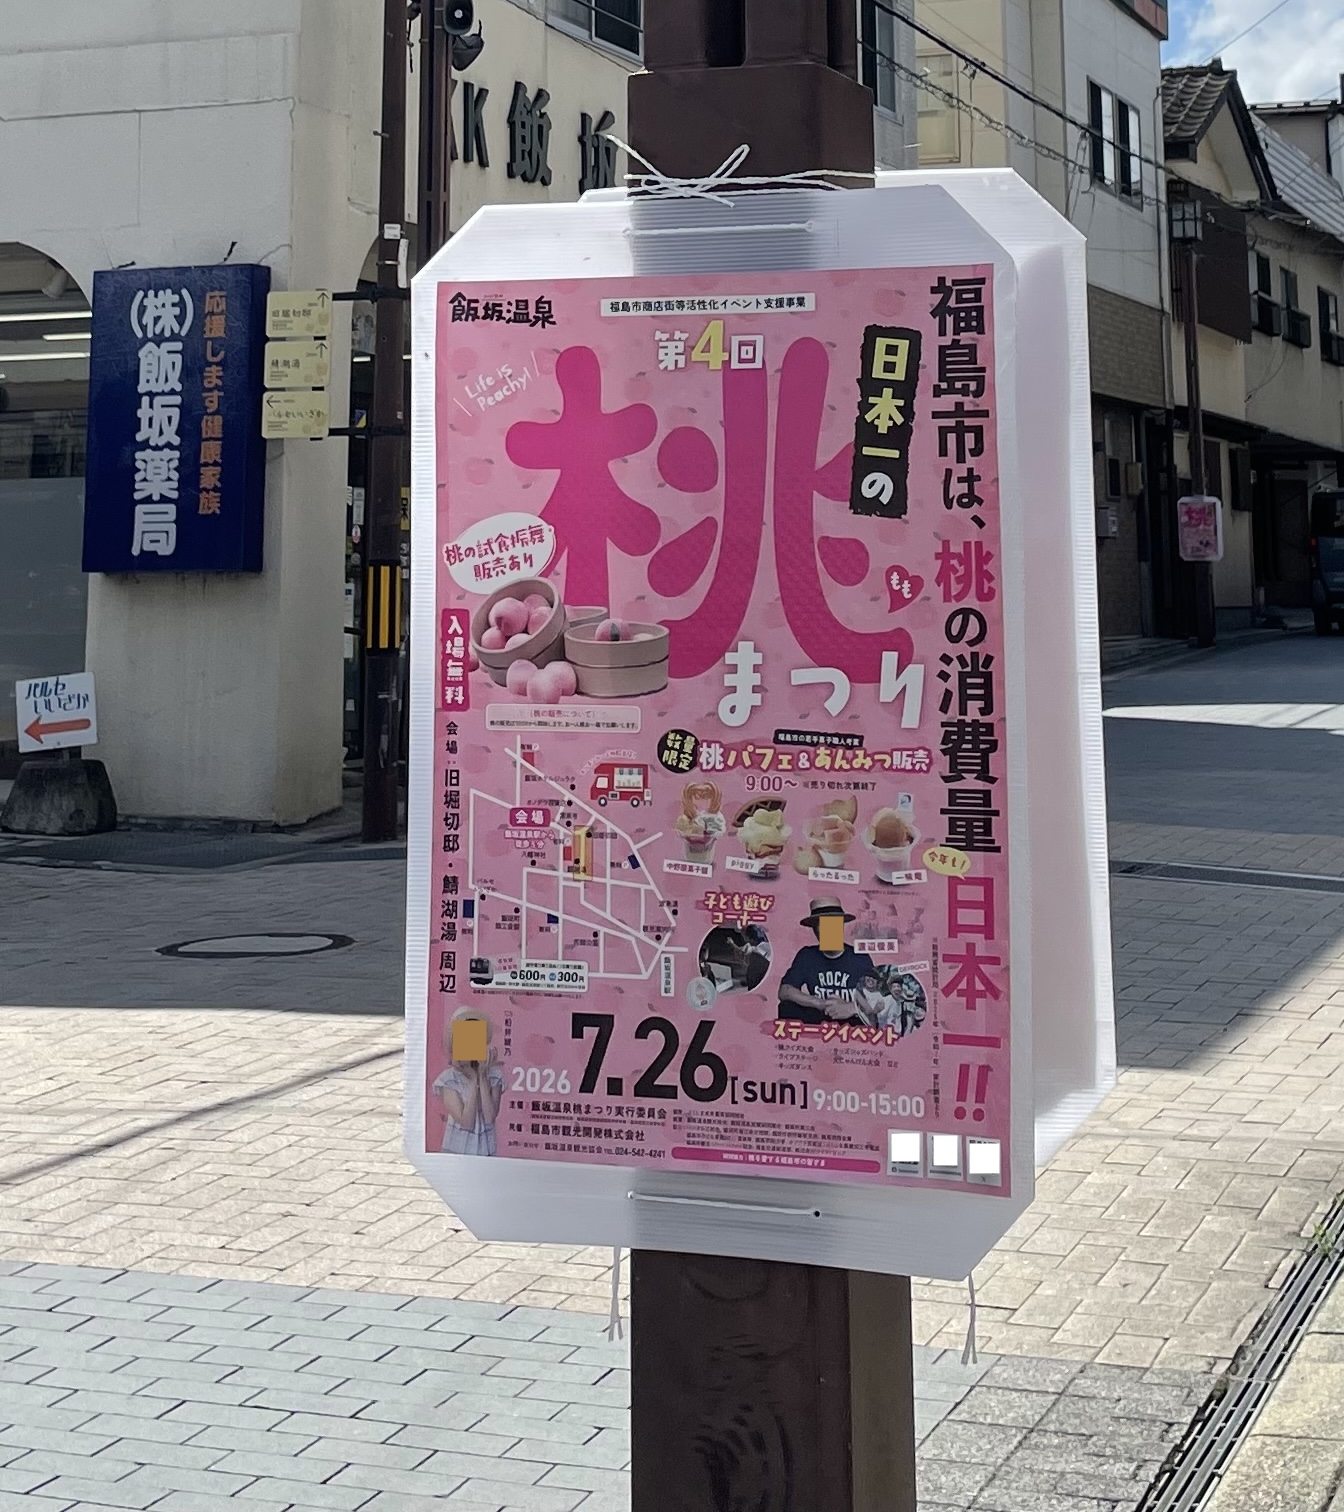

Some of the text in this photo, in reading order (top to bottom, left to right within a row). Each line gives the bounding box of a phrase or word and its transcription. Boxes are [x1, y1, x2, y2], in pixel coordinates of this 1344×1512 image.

[449, 292, 557, 329] 飯坂温泉
[609, 296, 807, 313] 福島市商店街等活性化イベント支援事業
[654, 319, 764, 370] 第4回
[464, 363, 513, 399] Life is
[197, 290, 227, 515] 応援します健康家族
[130, 287, 194, 557] (株)飯坂薬局
[859, 336, 909, 506] 日本一の
[505, 336, 914, 684] 桃
[445, 524, 545, 566] 桃の試食振舞
[473, 553, 534, 581] 販売あり
[890, 571, 913, 600] もも
[445, 616, 465, 705] 入場無料
[25, 675, 67, 700] パルセ
[718, 642, 925, 729] まつり
[666, 731, 696, 755] 数量
[699, 743, 931, 772] 桃パフェ&あんみつ販売
[661, 749, 694, 771] 限定
[515, 809, 544, 825] 会場
[704, 893, 775, 912] 子ども遊び
[712, 912, 767, 928] コーナー
[439, 951, 457, 994] 周辺
[818, 971, 851, 988] ROCK
[773, 1020, 900, 1047] ステージイベント
[570, 1012, 809, 1110] 7.26 [sun]
[511, 1066, 571, 1097] 2026
[531, 1100, 668, 1120] 飯坂温泉桃まつり実行委員会
[812, 1089, 926, 1118] 9:00-15:00
